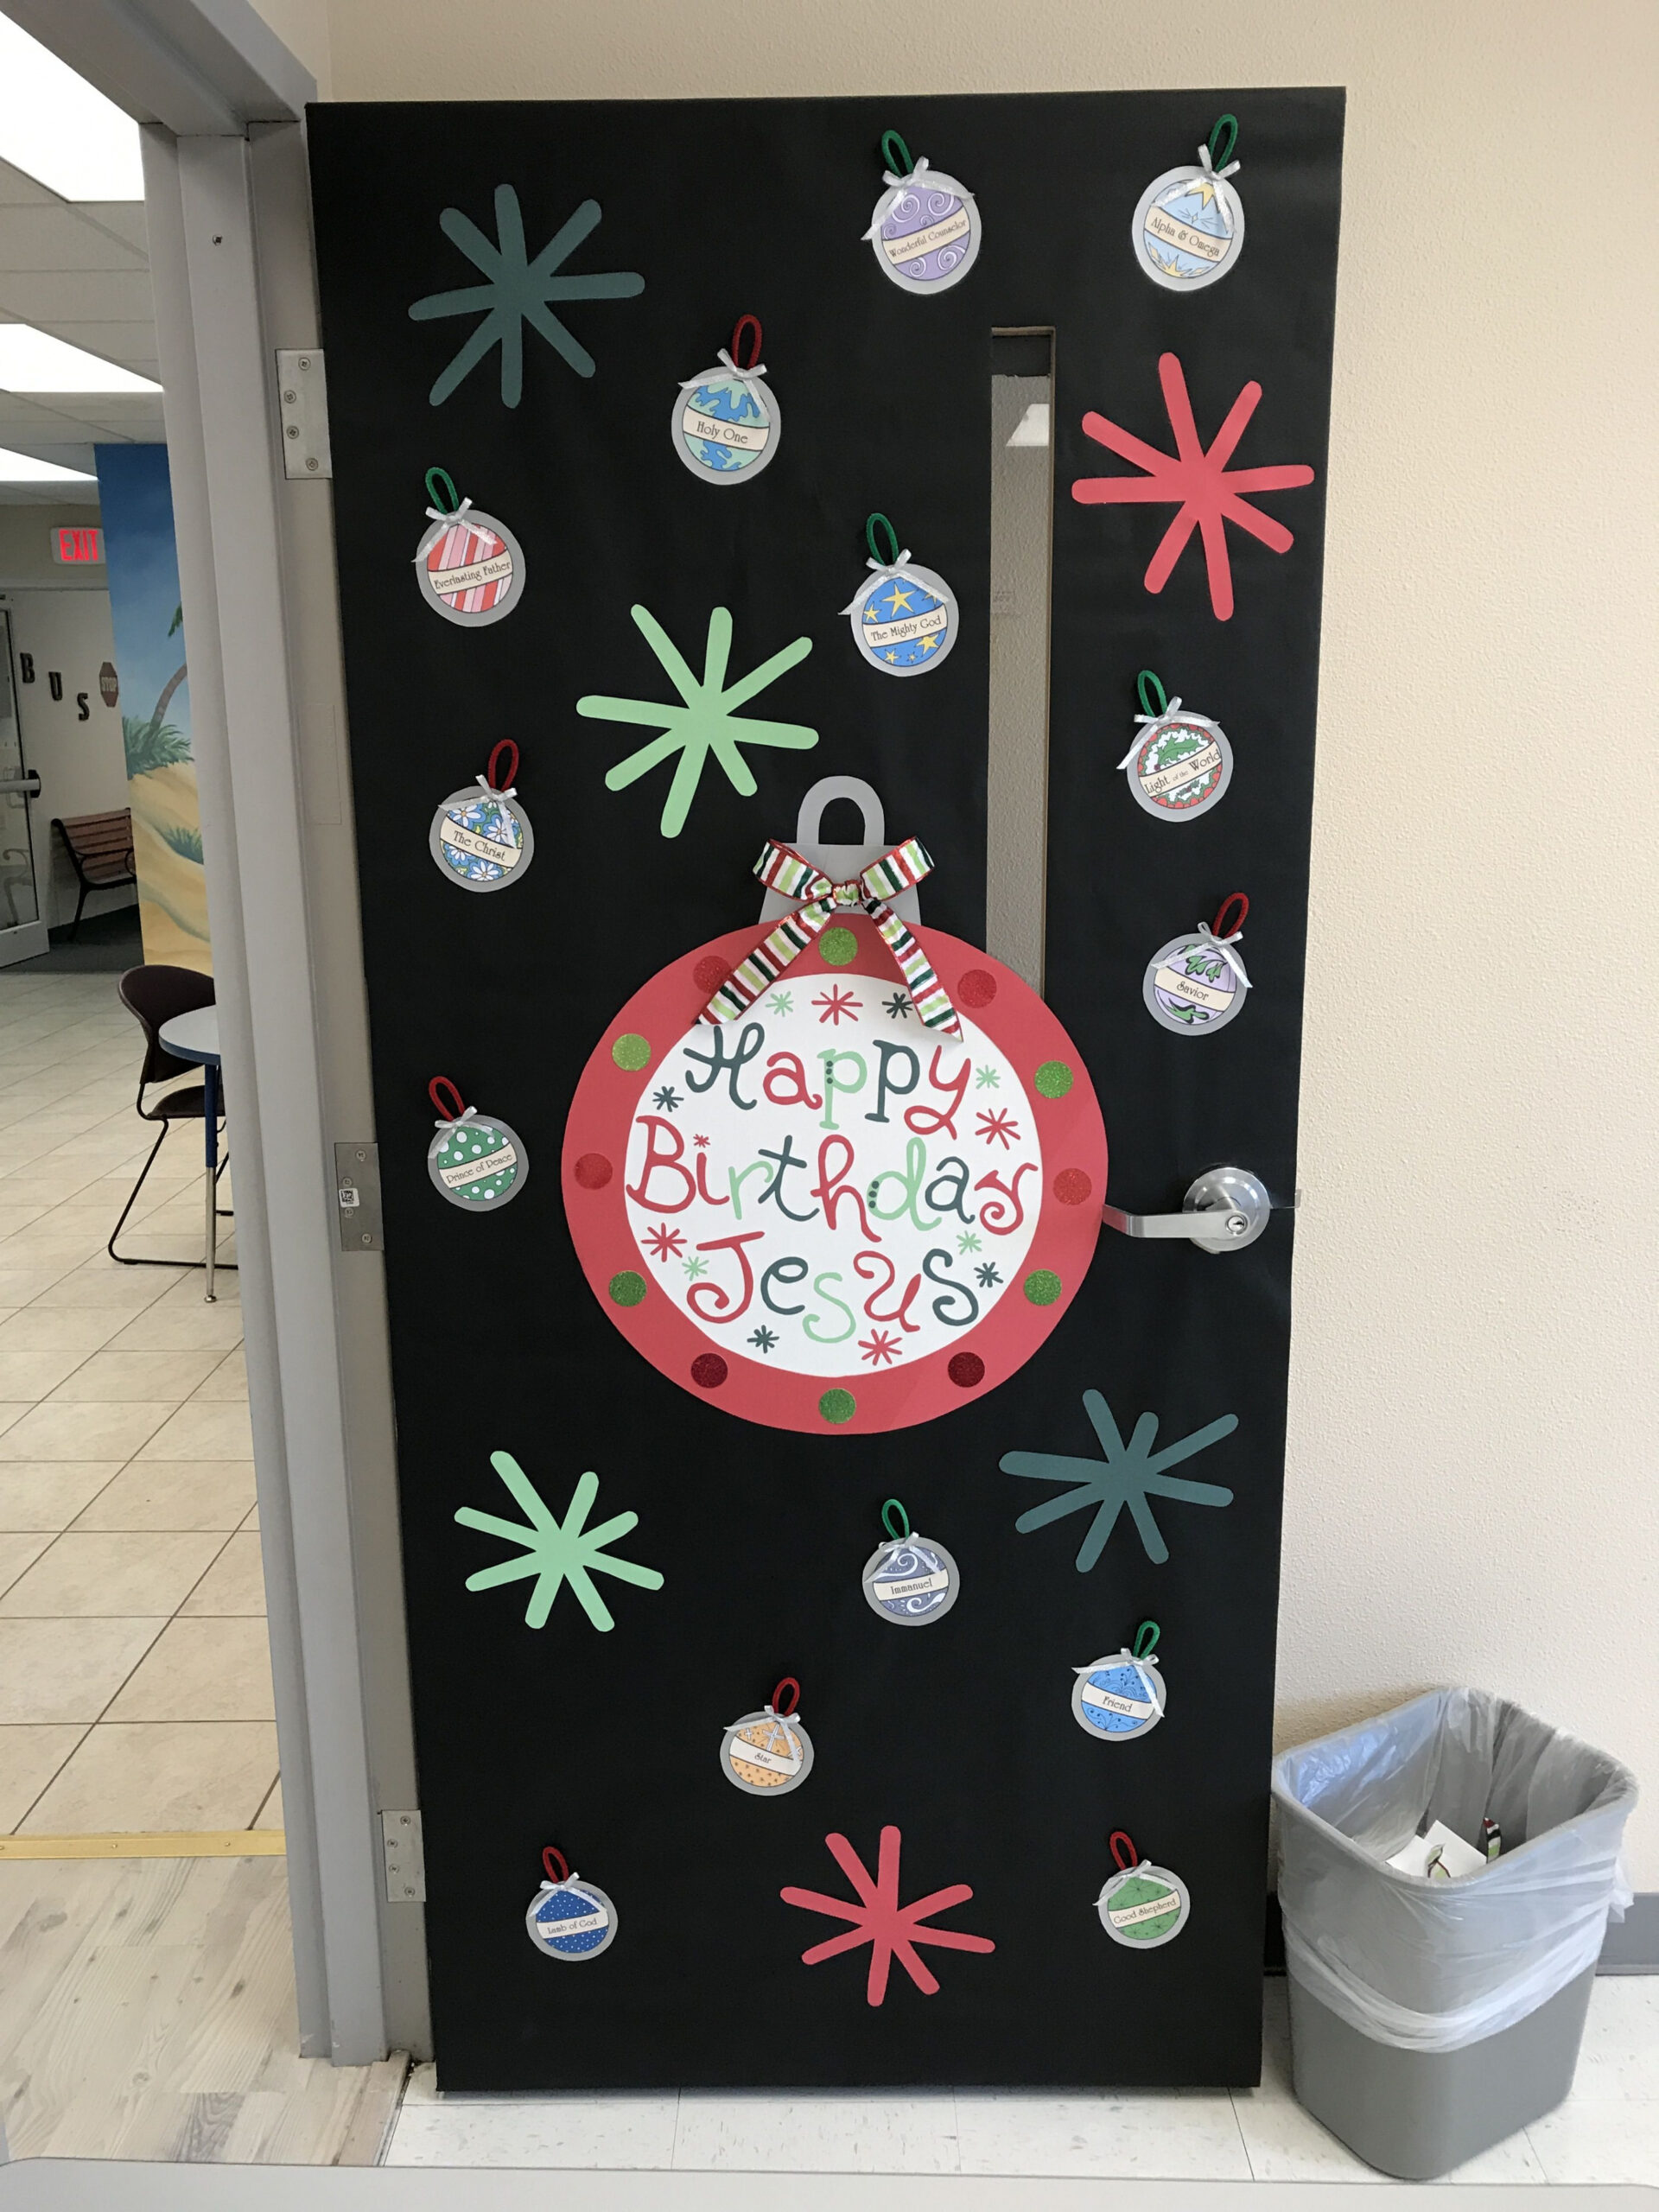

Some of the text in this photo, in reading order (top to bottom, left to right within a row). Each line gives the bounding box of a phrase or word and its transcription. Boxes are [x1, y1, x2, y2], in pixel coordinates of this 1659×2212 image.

[889, 219, 966, 257] Wonderful Counselor
[1151, 217, 1219, 257] Alpha & Omega
[696, 421, 748, 443] Holy One
[59, 530, 99, 562] EXIT
[434, 562, 511, 589] Everlasting Father
[870, 615, 941, 641] The Mighty God
[101, 677, 118, 692] STOP
[1144, 775, 1170, 794] Light
[1188, 749, 1221, 771] World
[454, 830, 505, 861] The Christ
[1176, 981, 1209, 1001] Savior
[683, 1022, 971, 1140] Happy
[446, 1154, 512, 1183] Prince of Peace
[626, 1115, 1039, 1243] Birthday
[686, 1231, 979, 1344] Jesus
[890, 1578, 933, 1595] Immanuel
[1102, 1695, 1133, 1713] Friend
[754, 1752, 772, 1764] Star
[1113, 1898, 1176, 1924] Good Shepherd
[547, 1923, 567, 1935] Lamb
[579, 1917, 597, 1928] God
